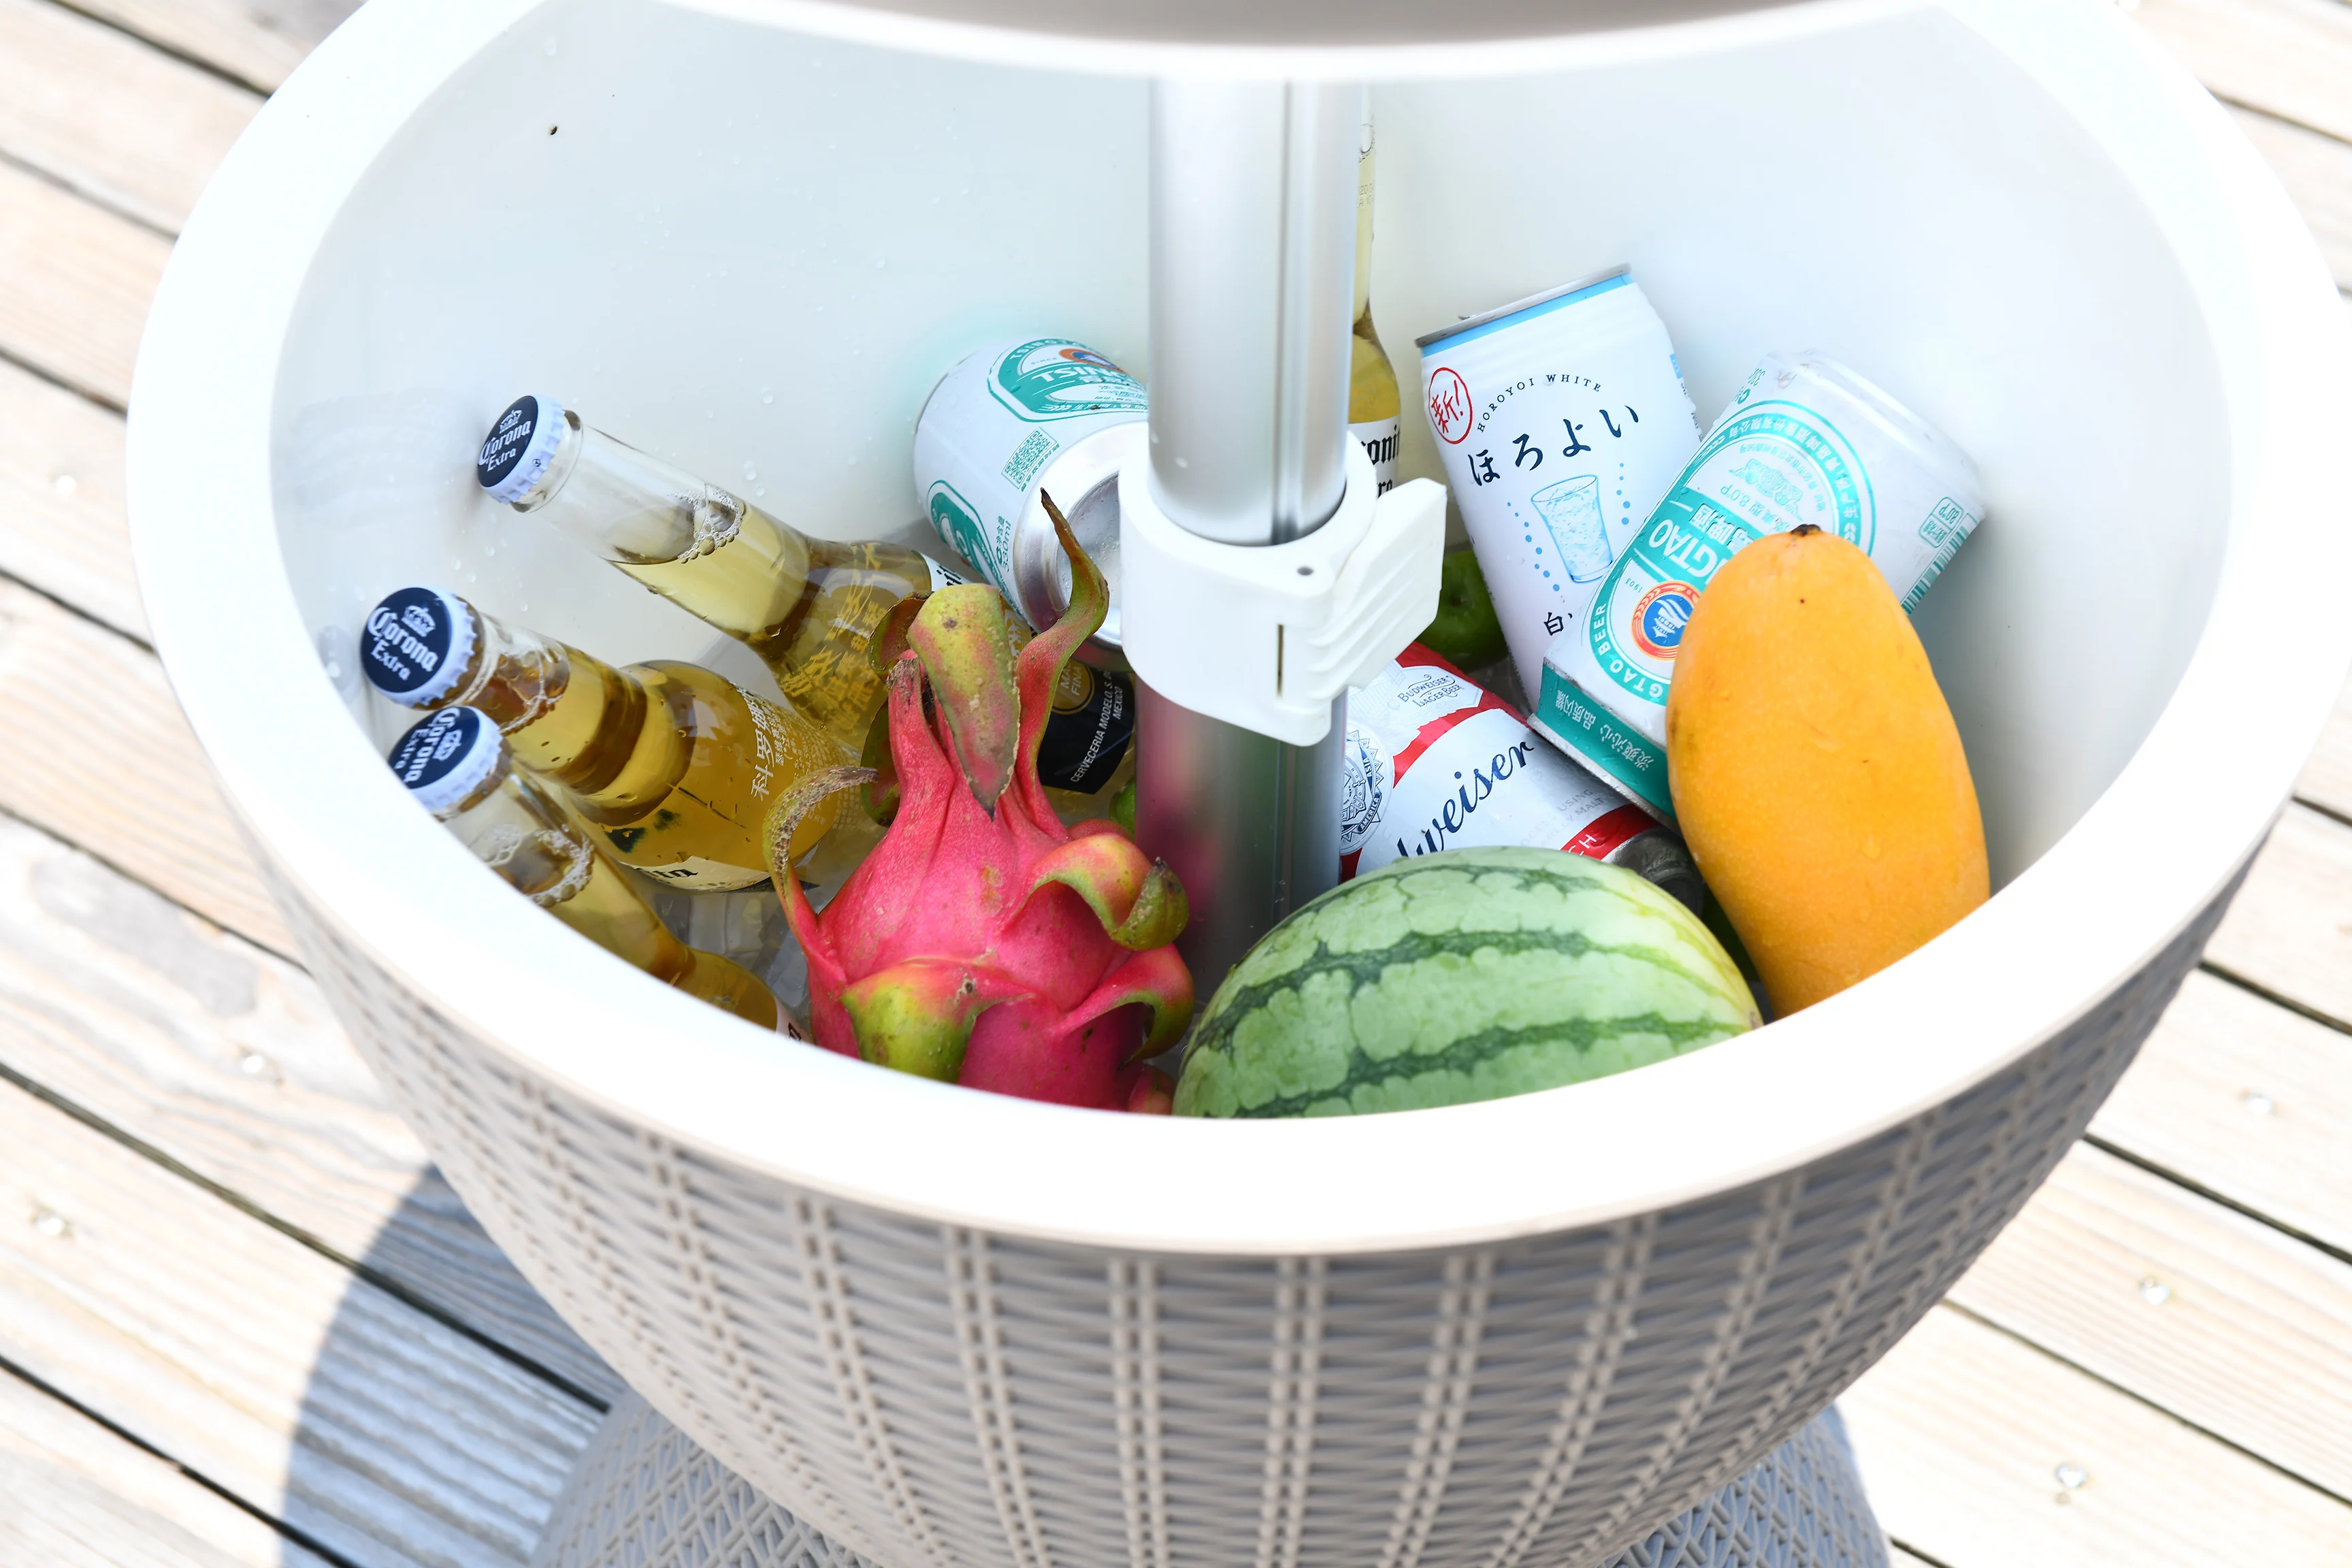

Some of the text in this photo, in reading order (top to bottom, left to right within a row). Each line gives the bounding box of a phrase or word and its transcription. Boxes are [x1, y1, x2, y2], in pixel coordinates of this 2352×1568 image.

[1477, 373, 1602, 434] HOROYOI WHITE
[478, 420, 531, 466] Corona
[487, 447, 517, 472] Extra
[1467, 405, 1639, 487] ほろよい
[1648, 519, 1728, 585] GTAO
[1624, 577, 1644, 593] 1903
[367, 607, 439, 672] Corona
[371, 639, 411, 681] Extra
[1593, 602, 1664, 698] GTAO BEER
[1071, 666, 1081, 696] FINA
[394, 728, 430, 770] Extra
[403, 707, 461, 783] Corona
[1070, 730, 1106, 783] CERVECERIA
[1363, 756, 1373, 778] ASIA
[1360, 798, 1380, 831] AMERICA
[1557, 789, 1593, 811] USING
[1575, 797, 1604, 815] MALT
